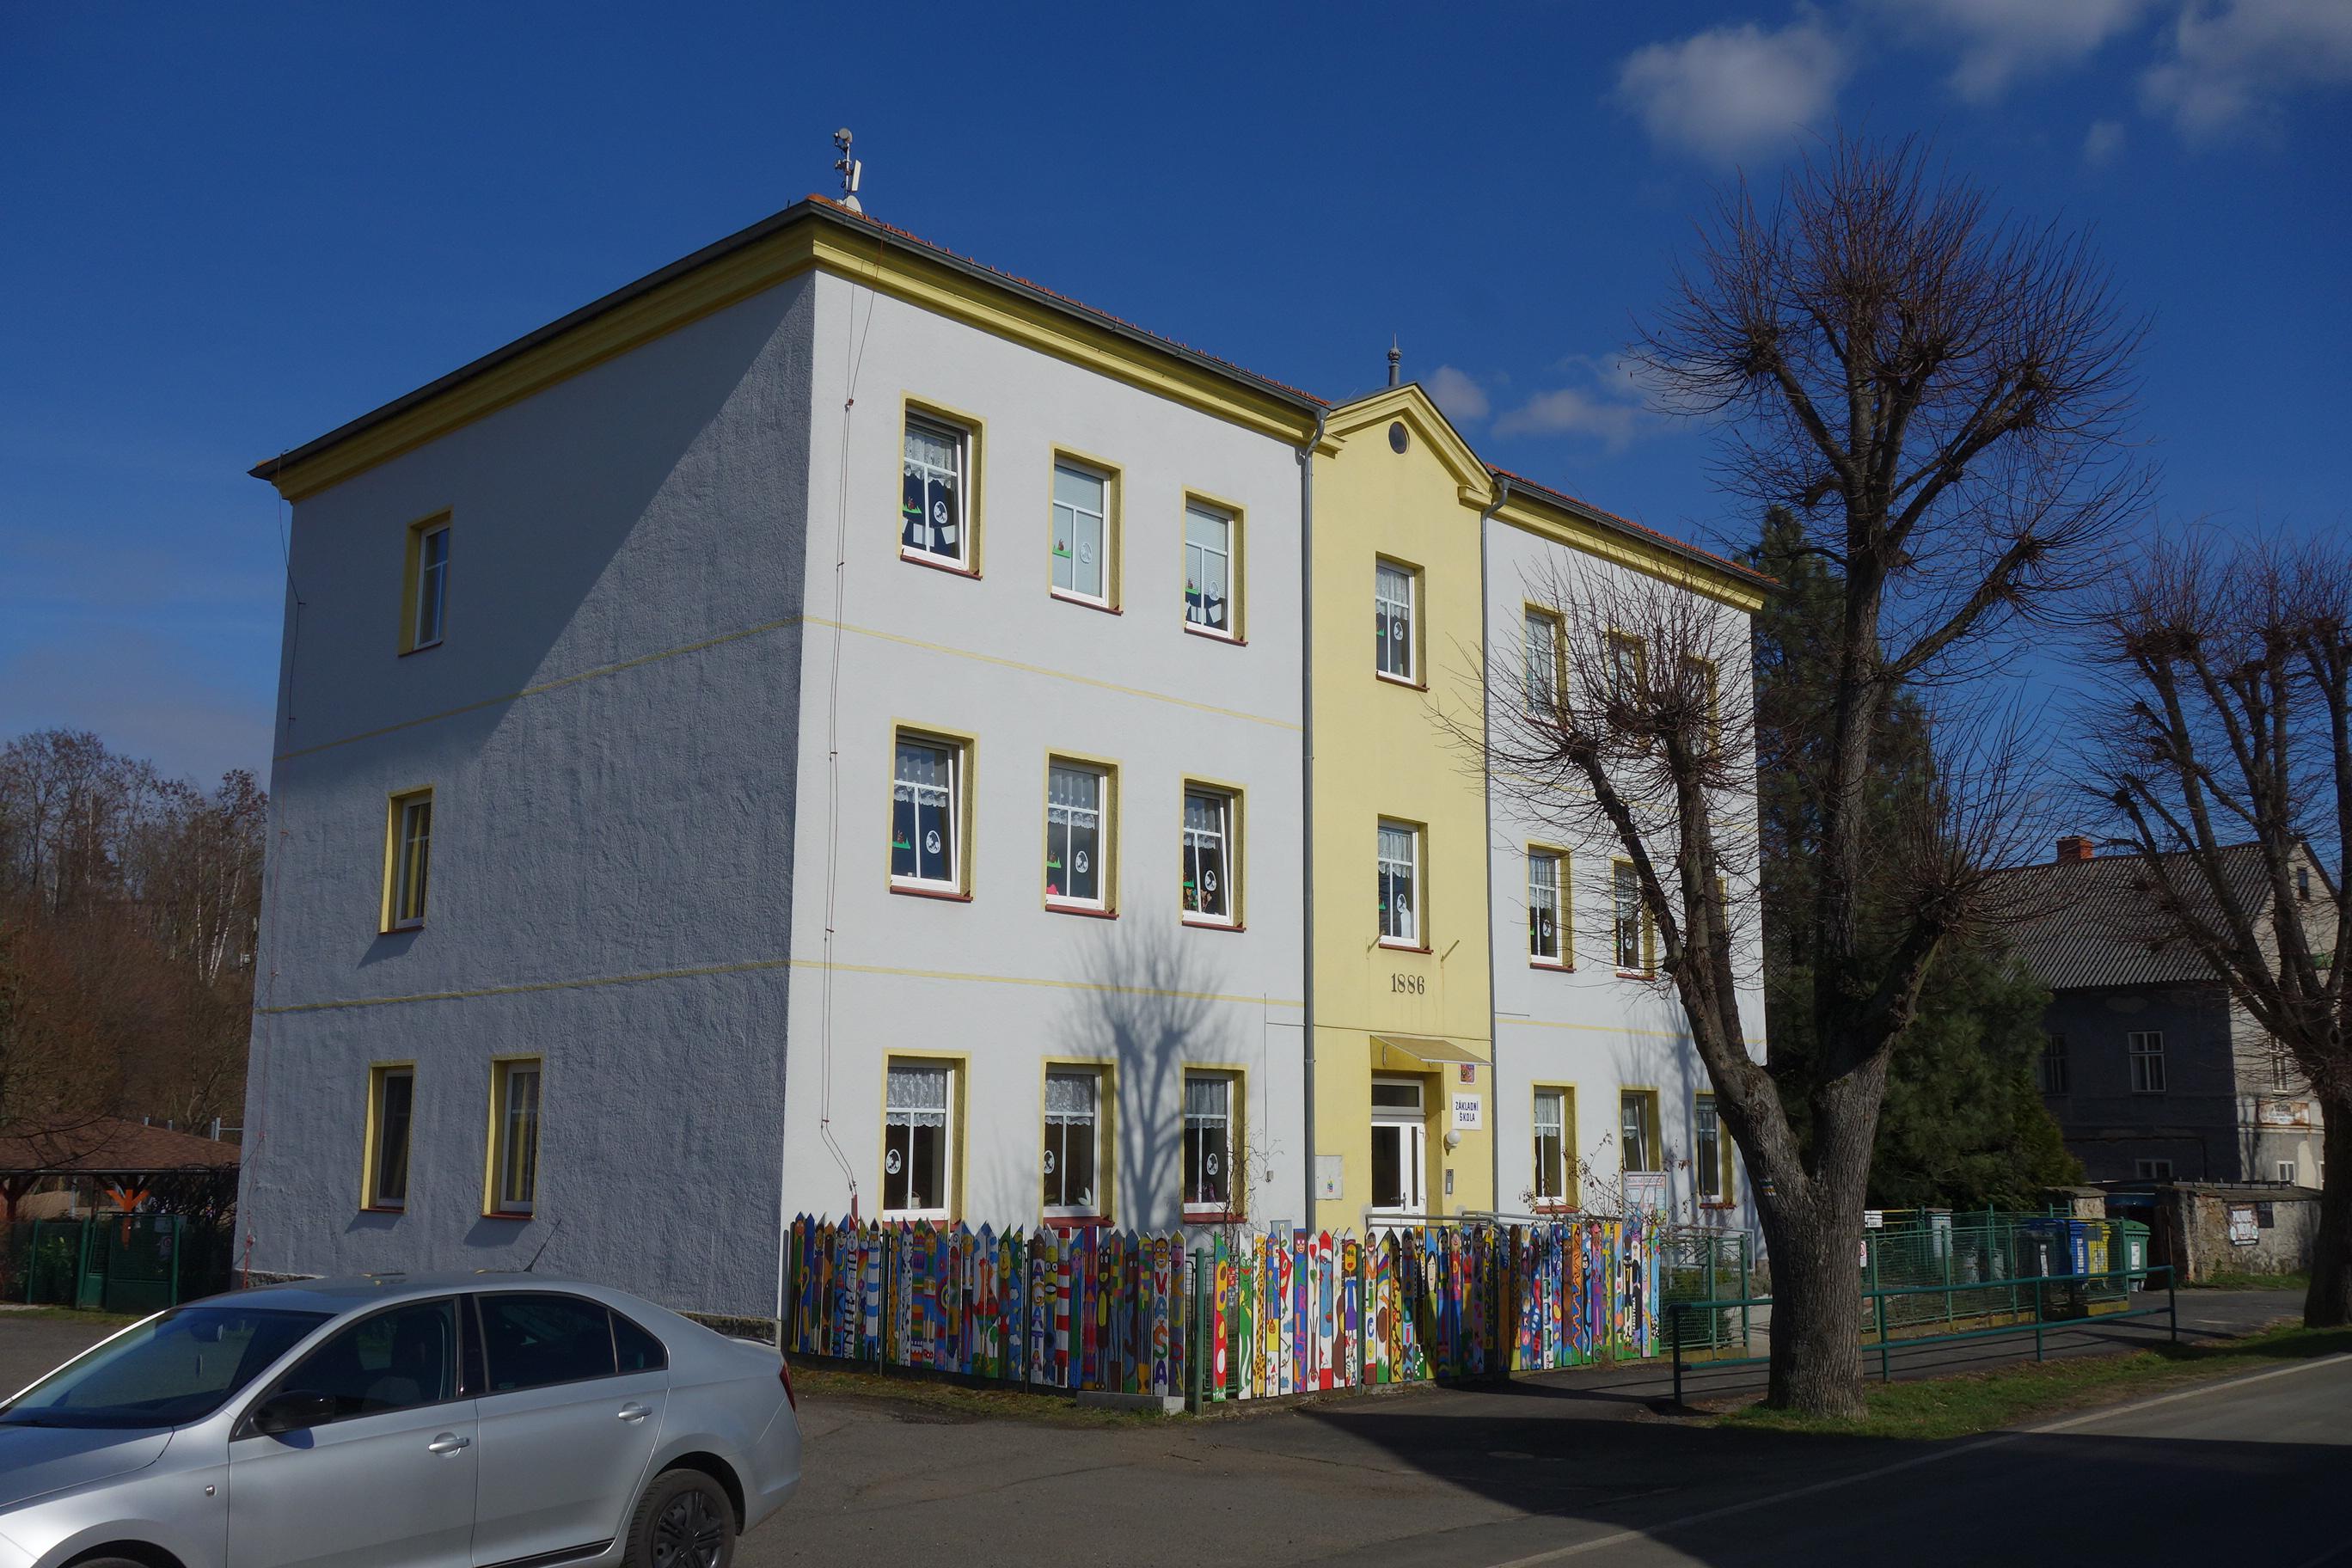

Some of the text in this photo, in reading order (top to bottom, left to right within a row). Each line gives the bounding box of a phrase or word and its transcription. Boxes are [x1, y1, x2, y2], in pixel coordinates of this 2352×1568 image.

[1391, 972, 1425, 995] 1886
[1455, 1100, 1479, 1112] ZÁKLADNÍ
[1459, 1112, 1476, 1122] ŠKOLA
[1031, 1260, 1046, 1372] AGATA
